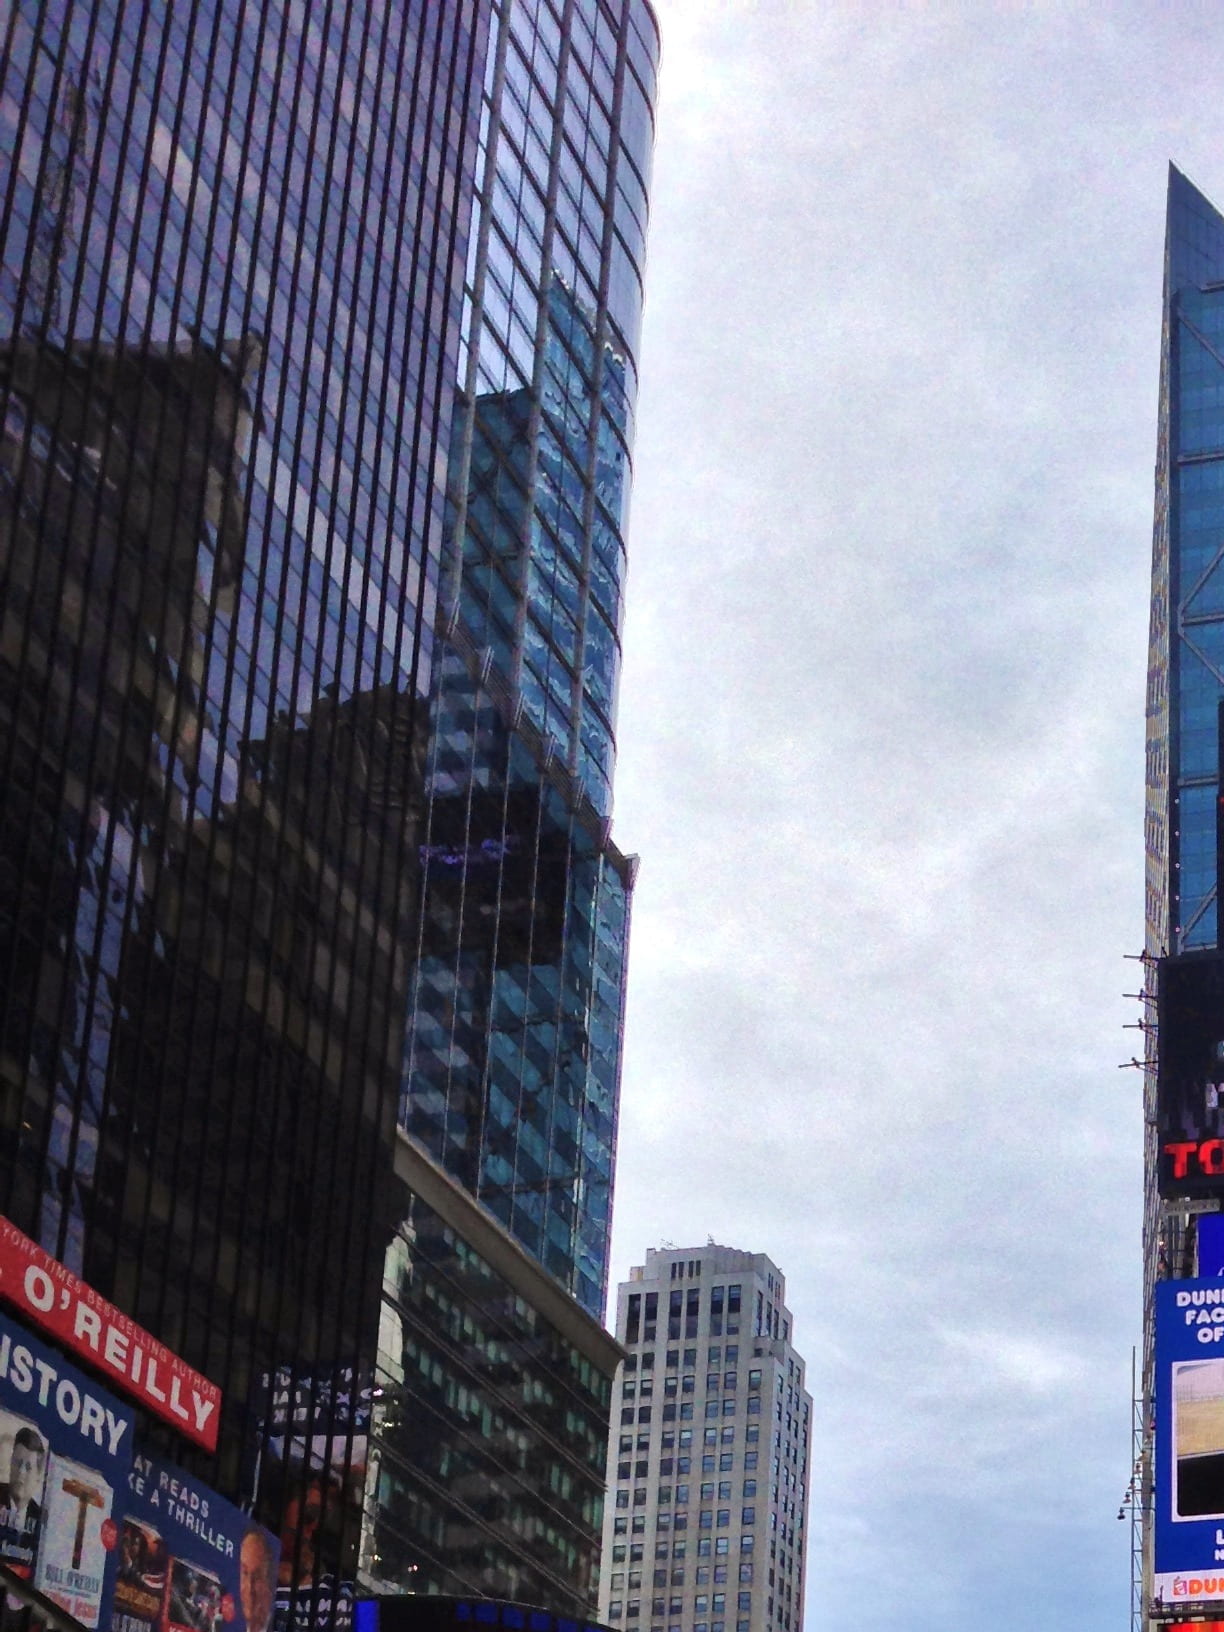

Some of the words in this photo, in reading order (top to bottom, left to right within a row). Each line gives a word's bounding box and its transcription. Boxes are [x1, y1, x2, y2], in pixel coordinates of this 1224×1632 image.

[3, 1224, 38, 1258] YORK
[43, 1255, 82, 1294] TIMES
[88, 1290, 167, 1363] BESTSELLING
[172, 1358, 217, 1400] AUTHOR
[24, 1264, 214, 1432] O'REILLY
[1197, 1326, 1224, 1343] OF
[0, 1334, 128, 1456] ISTORY
[150, 1489, 160, 1507] A
[167, 1498, 234, 1558] THRILLER
[159, 1471, 209, 1519] READS
